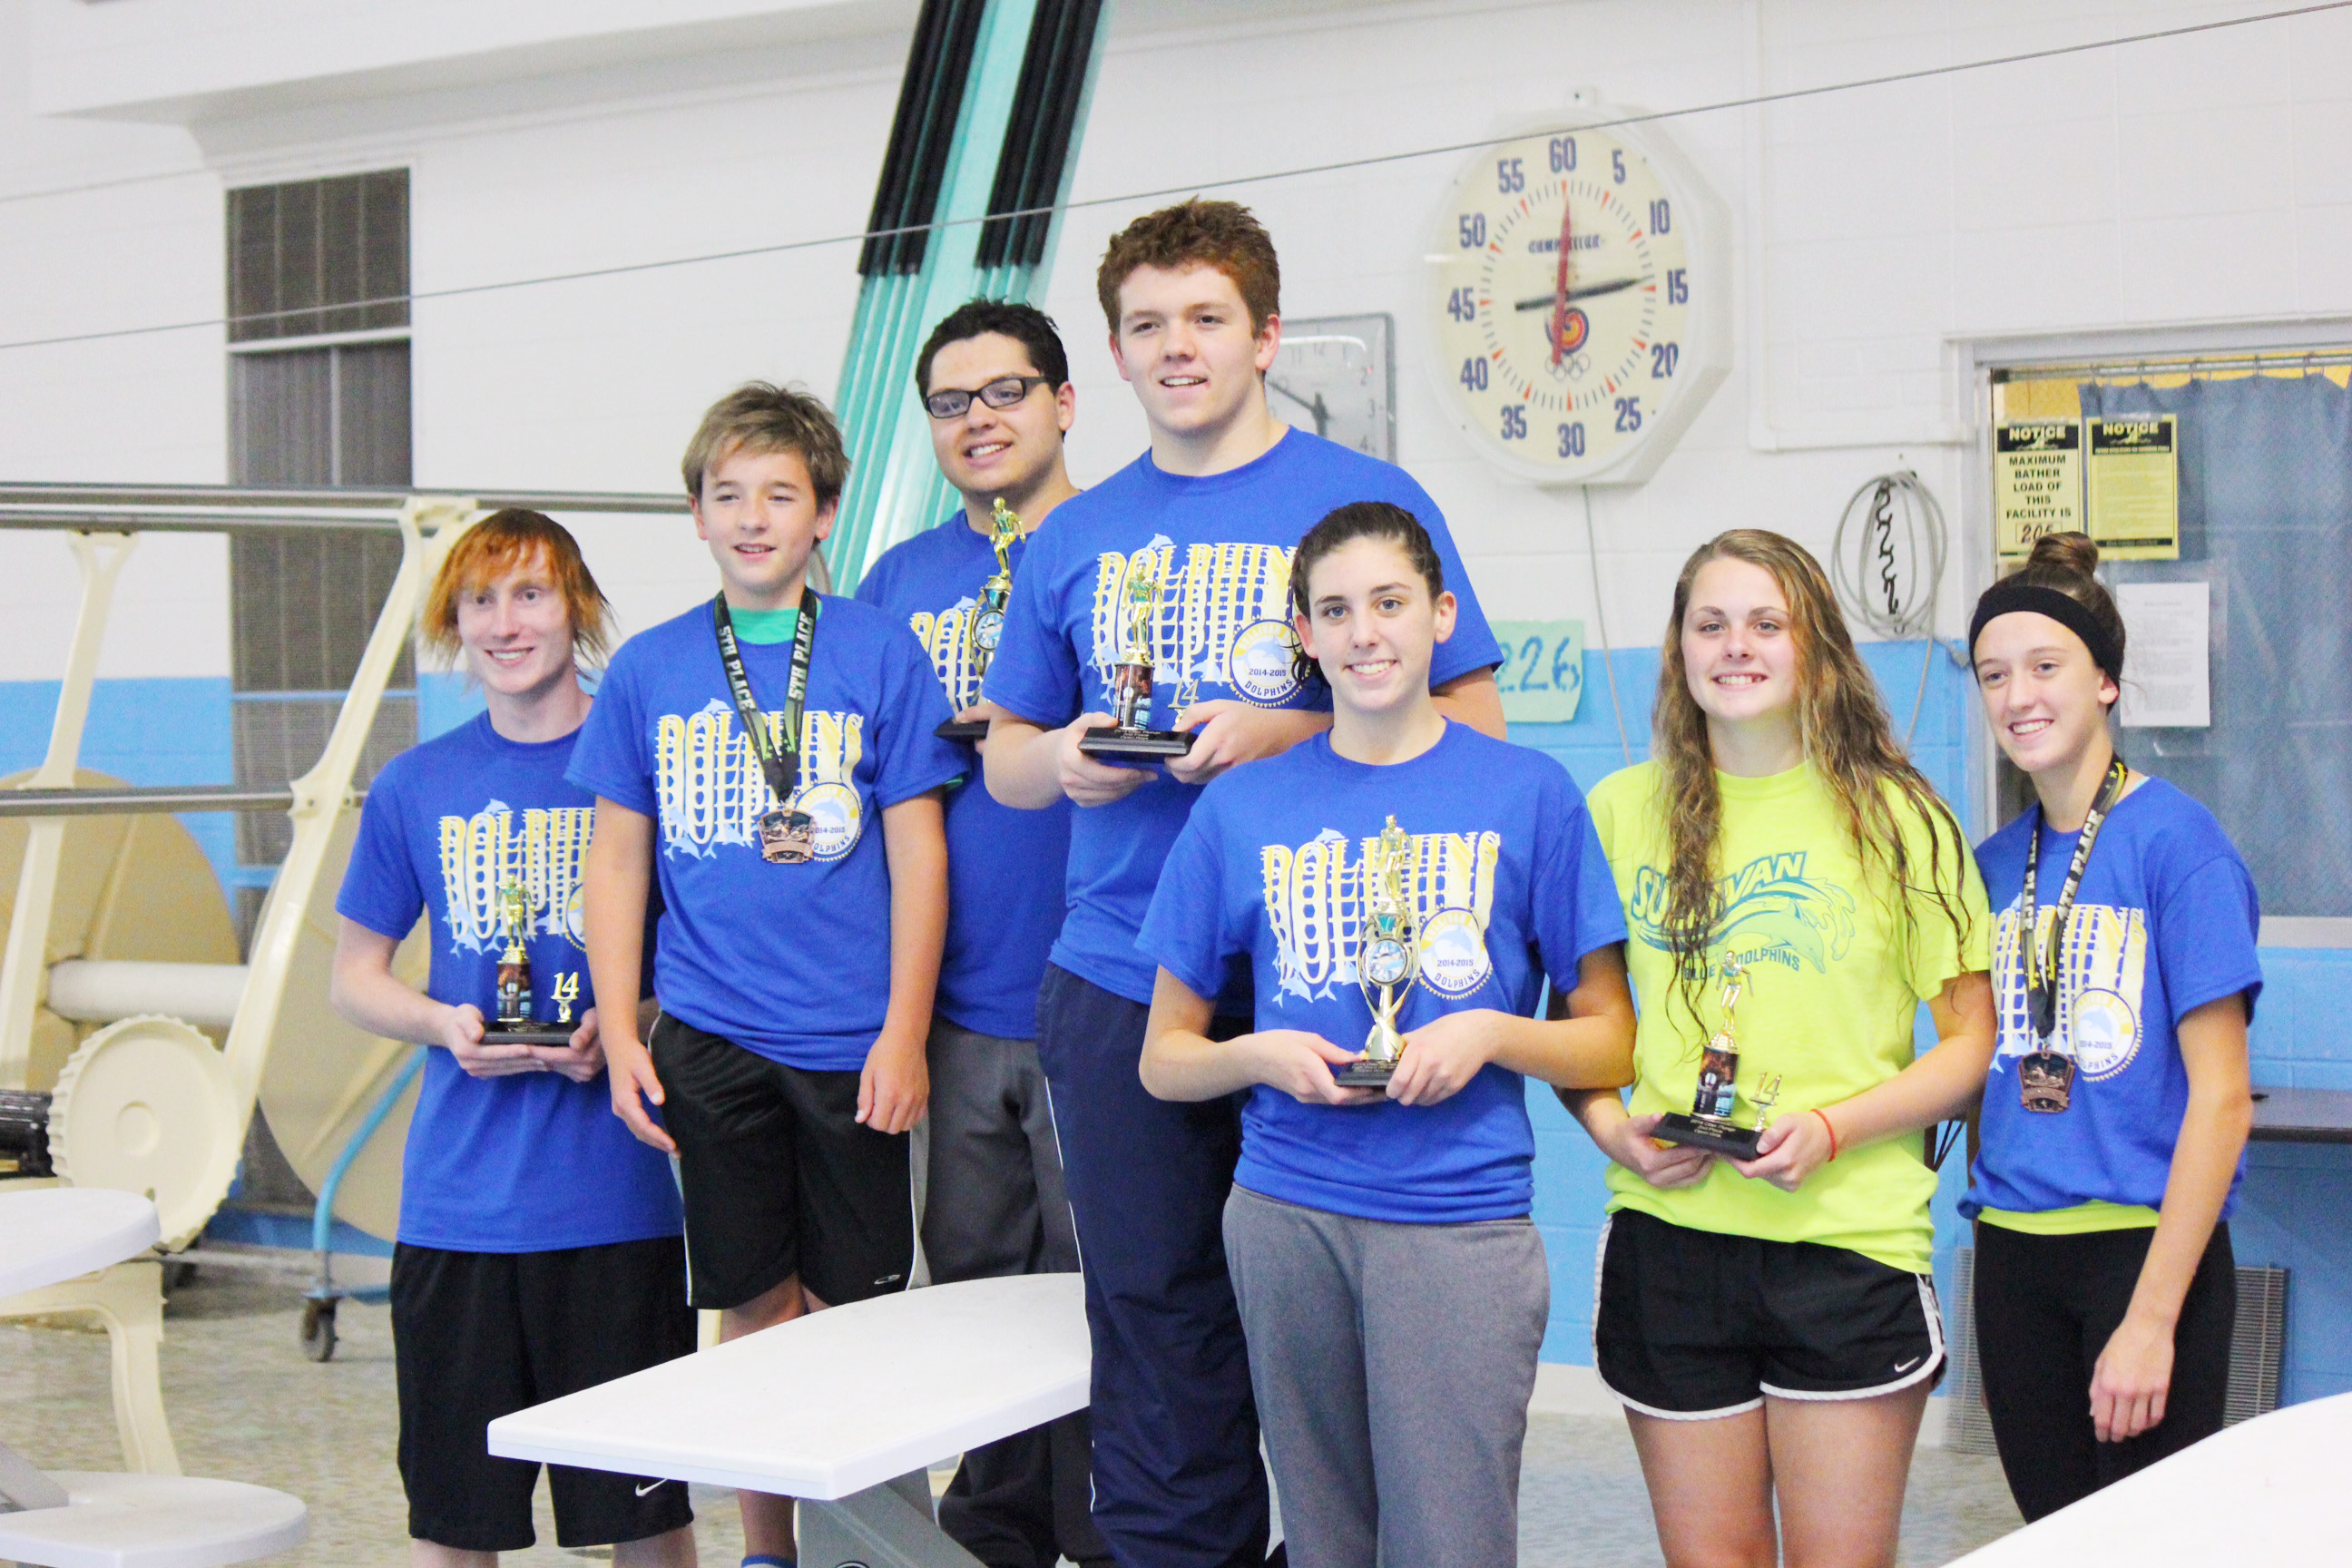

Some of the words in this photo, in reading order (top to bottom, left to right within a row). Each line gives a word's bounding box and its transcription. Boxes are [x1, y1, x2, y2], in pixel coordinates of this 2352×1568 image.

[1549, 137, 1577, 172] 60
[1612, 150, 1626, 184] 5
[1497, 159, 1524, 193] 55
[1459, 213, 1486, 249] 50
[1650, 199, 1671, 235] 10
[1667, 269, 1689, 304] 15
[1447, 288, 1475, 322] 45
[1461, 358, 1488, 391] 40
[1651, 343, 1679, 378] 20
[1500, 405, 1527, 440] 35
[1614, 397, 1642, 433] 25
[2102, 422, 2159, 436] NOTICE
[1558, 422, 1585, 457] 30
[2009, 426, 2066, 441] NOTICE
[2009, 455, 2066, 466] MAXIMUM
[2014, 468, 2060, 479] BATHER
[2014, 482, 2043, 493] LOAD
[2047, 482, 2062, 492] OF
[2026, 495, 2051, 505] THIS
[2006, 508, 2055, 519] FACILITY
[2061, 509, 2072, 517] IS
[1092, 543, 1296, 684] DOLPHIN
[718, 625, 738, 657] 5TH
[792, 612, 814, 663] PLACE
[727, 659, 757, 710] PLACE
[788, 665, 808, 700] 5TH
[1244, 679, 1293, 697] DOLPHINS
[1249, 669, 1287, 677] 2014-2015
[1168, 679, 1200, 710] 14
[813, 835, 850, 853] OLPHINS
[2070, 809, 2106, 872] PLACE
[1632, 851, 1808, 929] SUVAN
[1437, 959, 1474, 967] 2014-2015
[1736, 948, 1800, 972] DOLPHINS
[551, 972, 580, 1000] 14
[1435, 969, 1480, 988] DOLPHINS
[1749, 1072, 1781, 1106] 14
